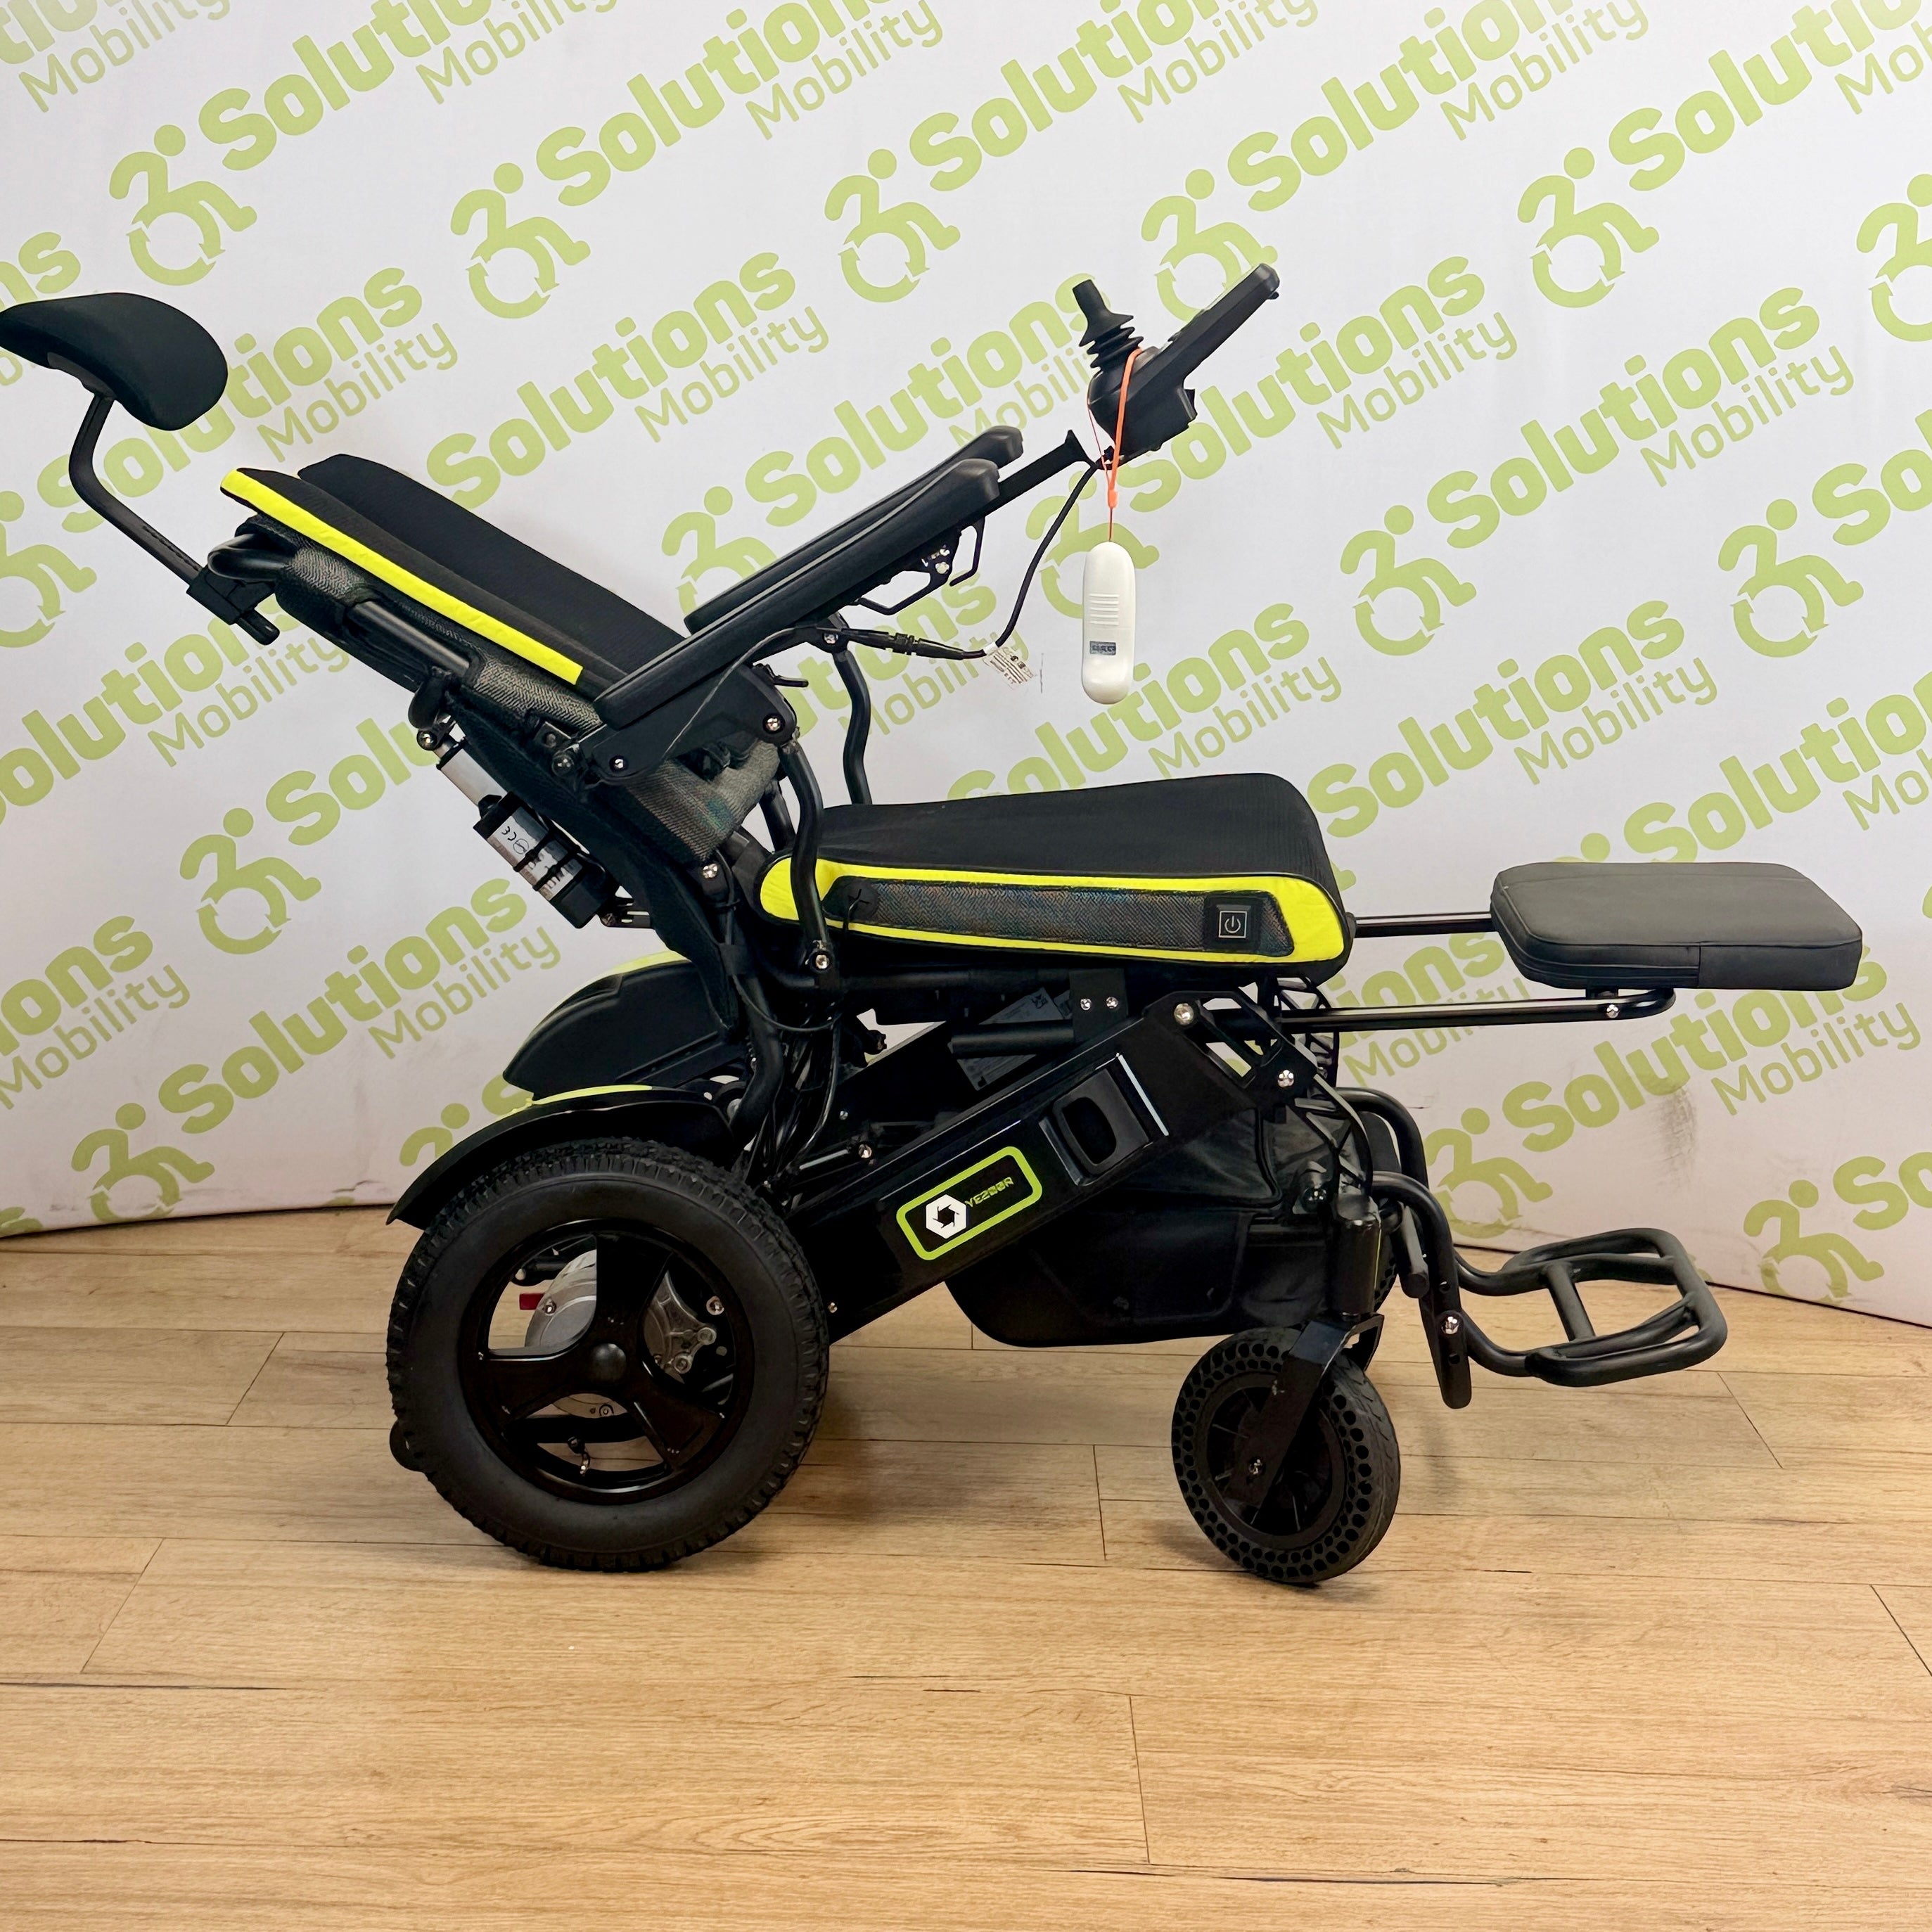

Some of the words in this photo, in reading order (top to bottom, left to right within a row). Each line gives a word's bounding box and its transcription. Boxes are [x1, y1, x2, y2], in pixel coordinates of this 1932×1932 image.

[745, 0, 943, 141] Mobility
[1440, 0, 1649, 141] Mobility
[257, 323, 458, 462] Mobility
[426, 252, 795, 511] Solutions
[635, 307, 829, 442] Mobility
[1317, 312, 1517, 449] Mobility
[1426, 288, 1820, 549] Solutions
[1641, 345, 1854, 487] Mobility
[147, 636, 350, 767] Mobility
[1149, 656, 1341, 778] Mobility
[1307, 601, 1686, 838] Solutions
[1514, 658, 1717, 786] Mobility
[0, 964, 191, 1110] Mobility
[159, 878, 527, 1134] Solutions
[368, 922, 561, 1060] Mobility
[1710, 1002, 1921, 1116] Mobility
